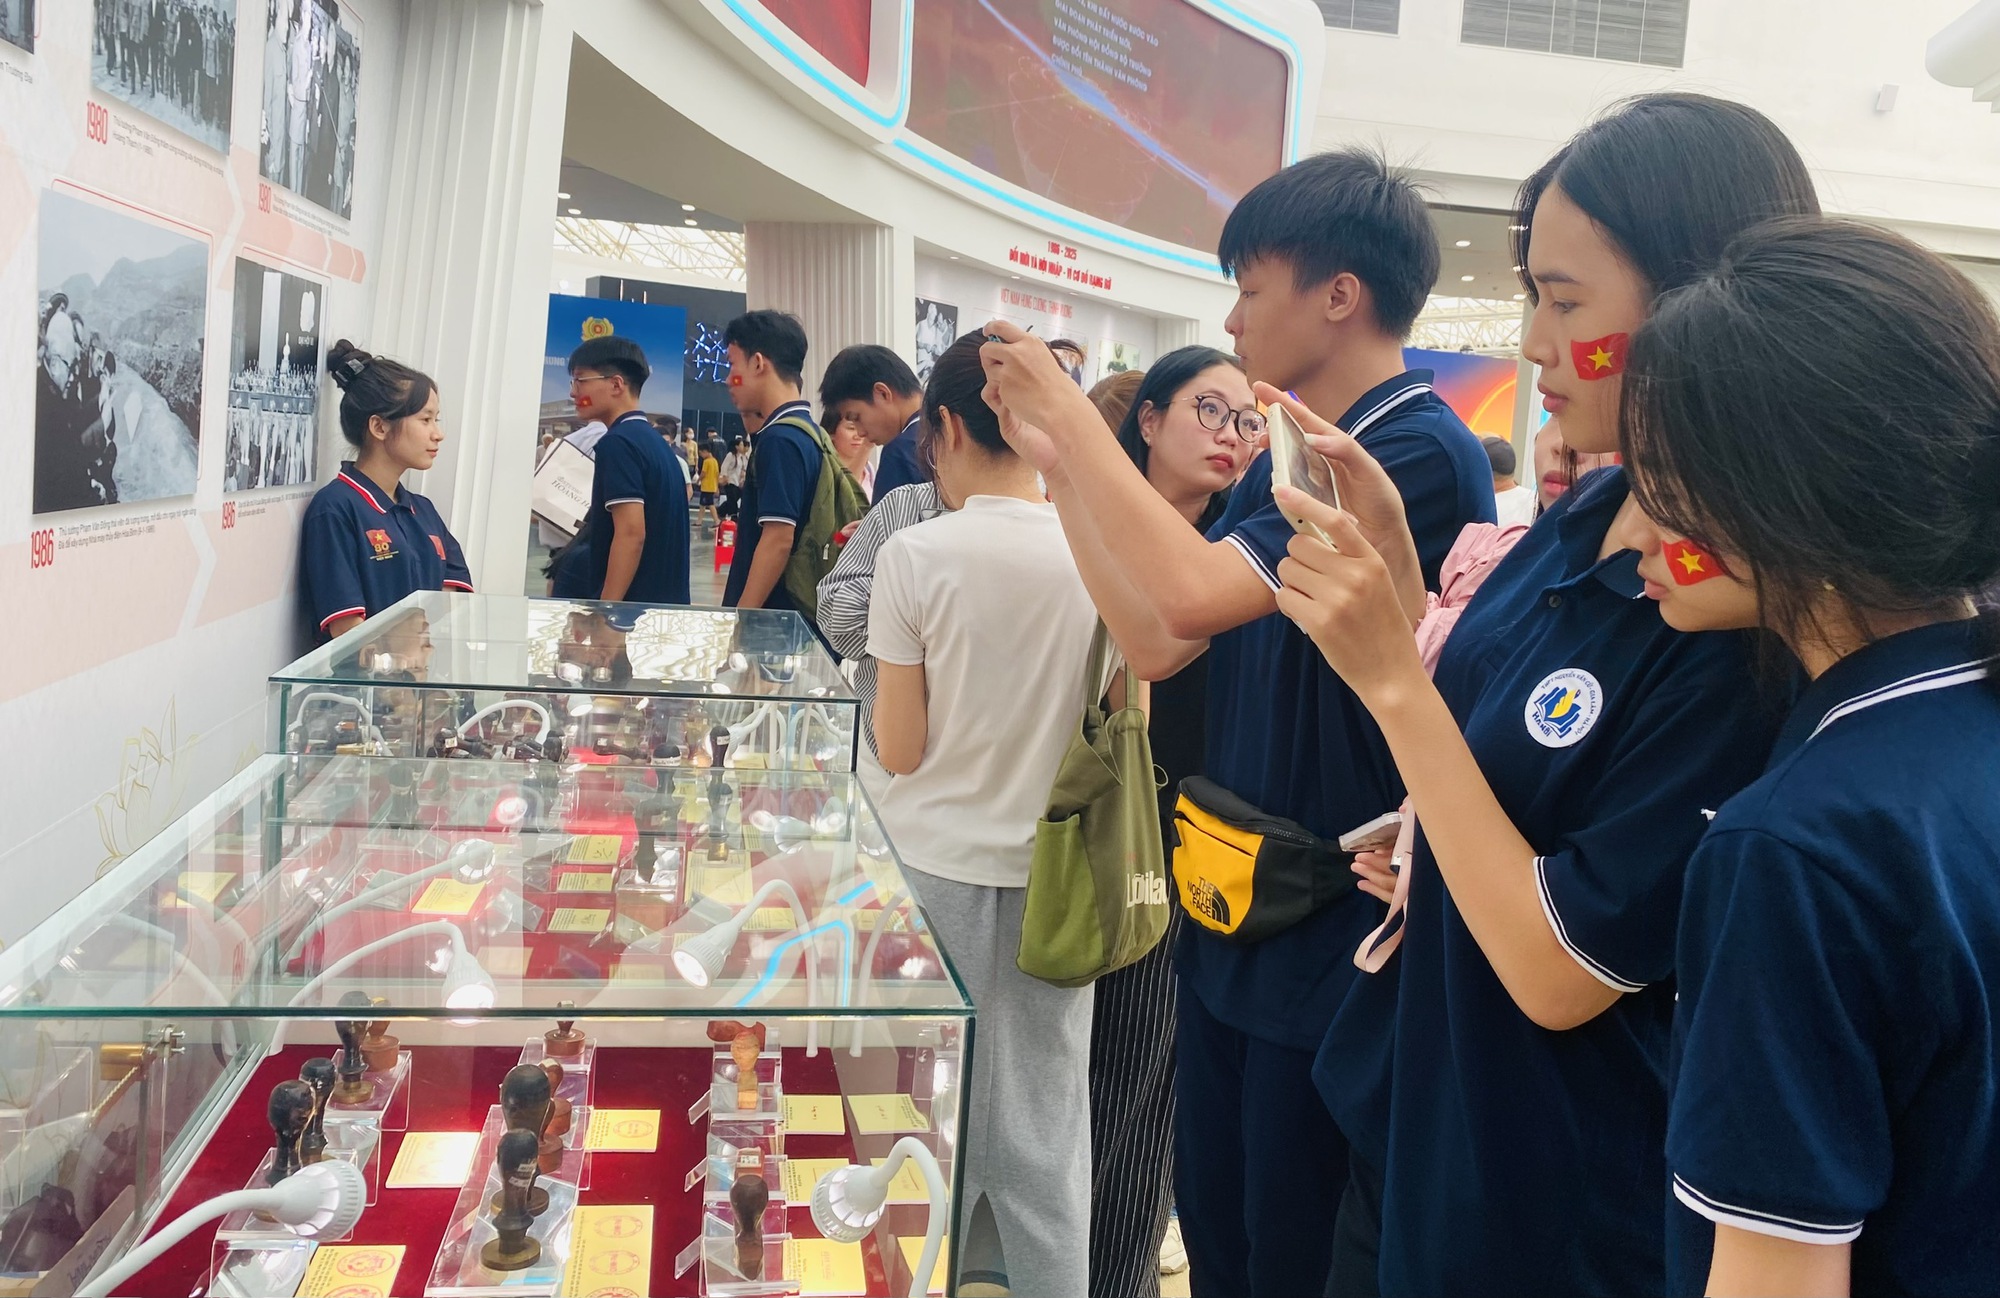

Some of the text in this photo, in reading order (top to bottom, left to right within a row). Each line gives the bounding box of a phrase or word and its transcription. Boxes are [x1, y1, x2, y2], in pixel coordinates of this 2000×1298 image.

[87, 101, 108, 145] 1980
[258, 183, 271, 214] 1980
[1064, 246, 1077, 260] 2025
[222, 501, 235, 530] 1986
[31, 528, 54, 569] 1986
[374, 542, 390, 553] 80
[1187, 880, 1213, 907] NORTH
[1199, 876, 1214, 893] THE
[1193, 896, 1212, 918] FACE
